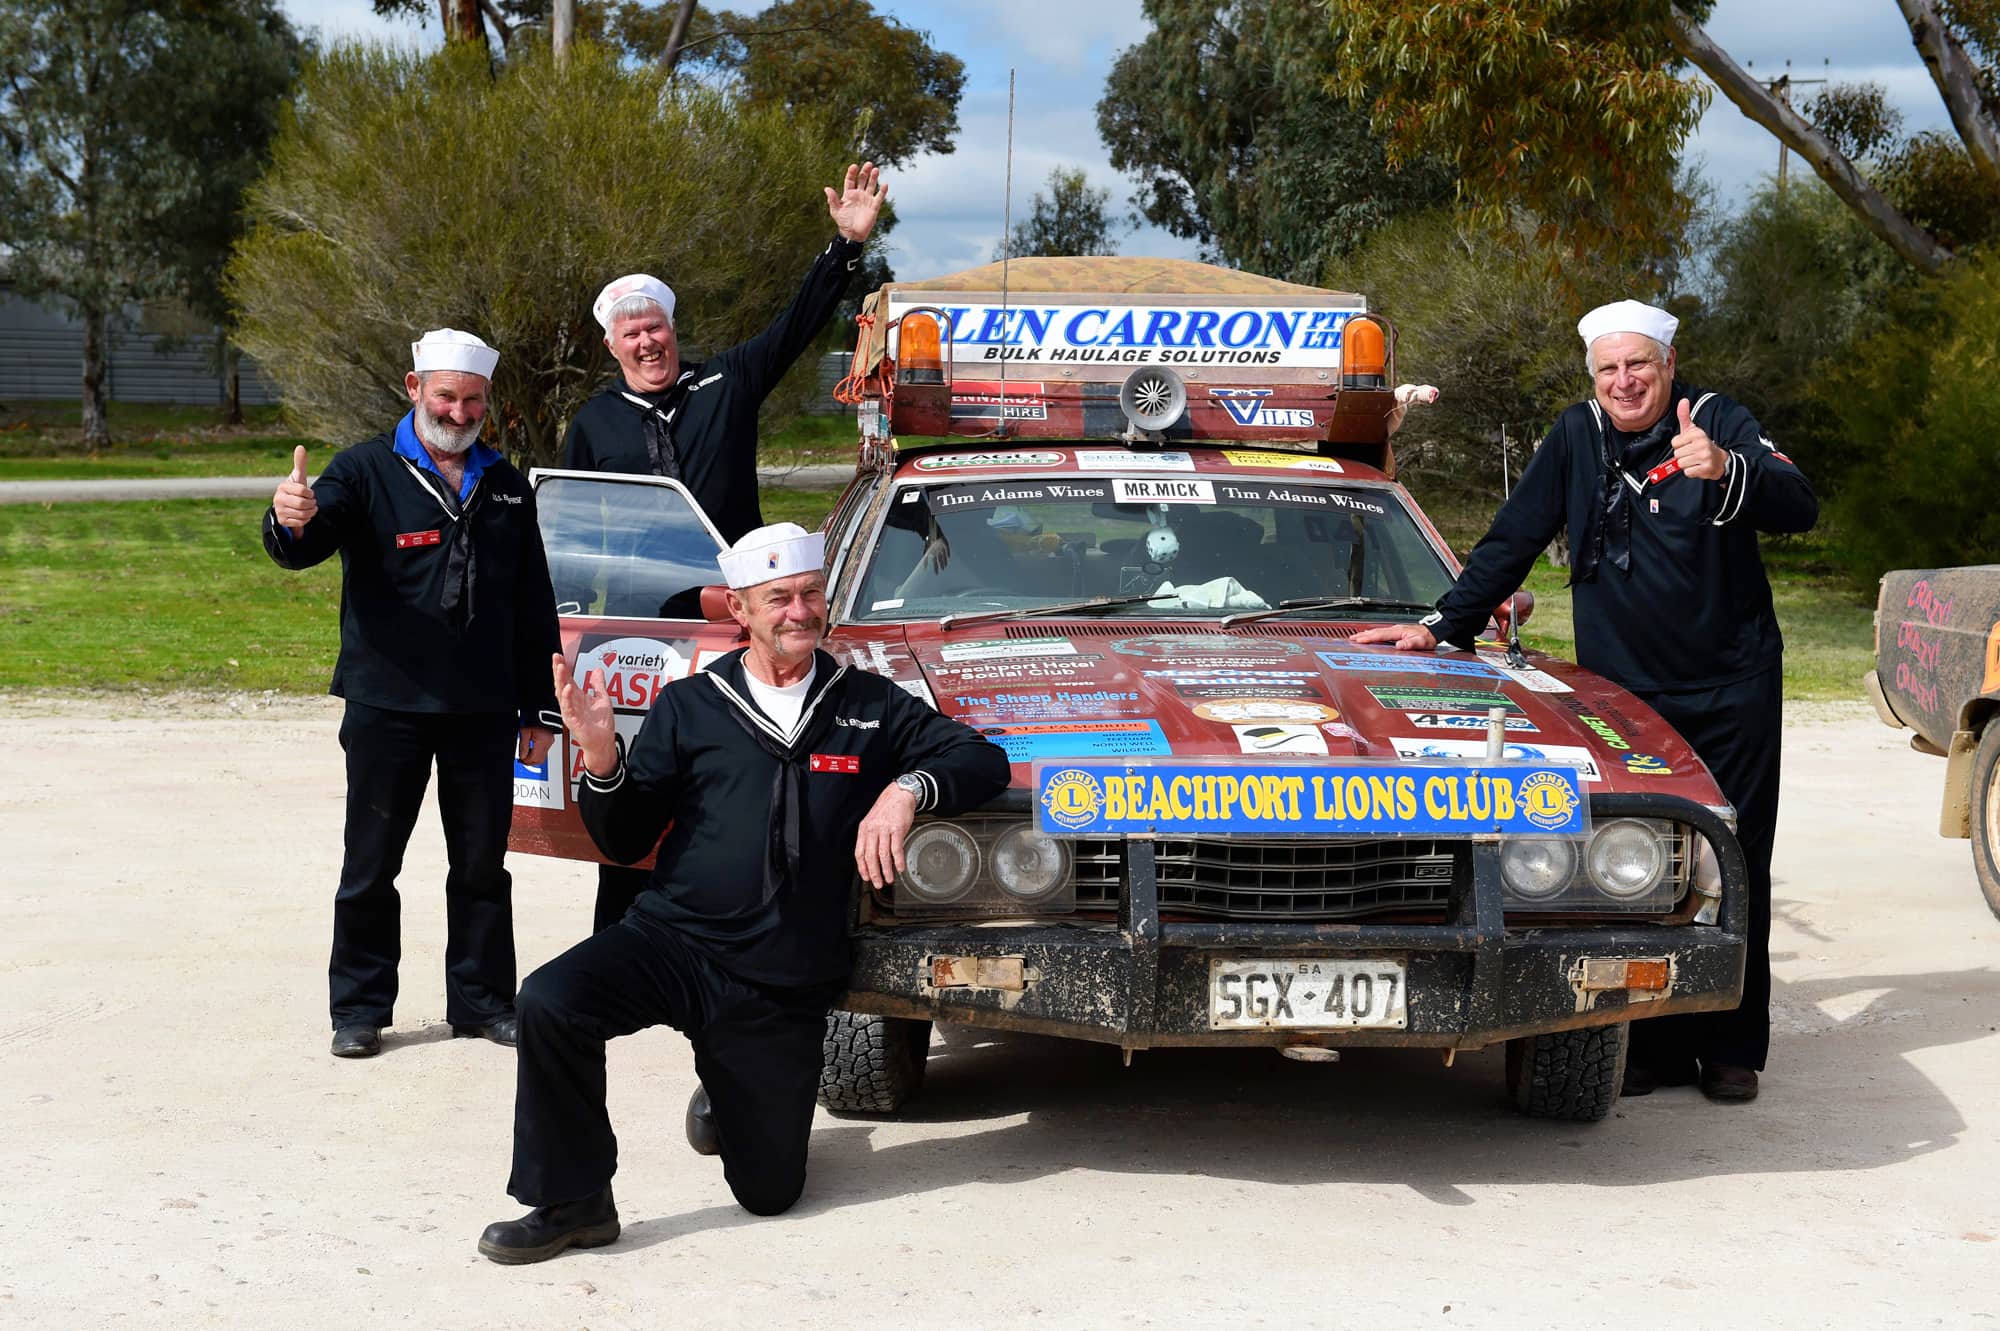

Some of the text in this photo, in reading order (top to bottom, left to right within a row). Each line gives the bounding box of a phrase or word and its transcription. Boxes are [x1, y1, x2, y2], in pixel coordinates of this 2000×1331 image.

[918, 306, 1307, 349] LEN CARRON
[984, 347, 1282, 364] BULK HAULAGE SOLUTIONS
[1004, 407, 1041, 417] HIRE
[937, 486, 1105, 506] Tim Adams Wines
[1222, 488, 1384, 514] Tim Adams Wines
[618, 653, 670, 671] variety
[935, 664, 1038, 676] Beachport
[1043, 661, 1095, 670] Hotel
[961, 670, 1023, 680] Social
[1028, 668, 1075, 677] Club
[955, 690, 1139, 706] The Sheep Handlers
[1578, 714, 1632, 750] CARPET
[1053, 772, 1093, 786] LIONS
[1526, 773, 1565, 787] LIONS
[1068, 788, 1083, 807] L
[1103, 775, 1516, 821] BEACHPORT LIONS CLUB
[1540, 789, 1557, 808] L
[1219, 972, 1399, 1019] SGX 407
